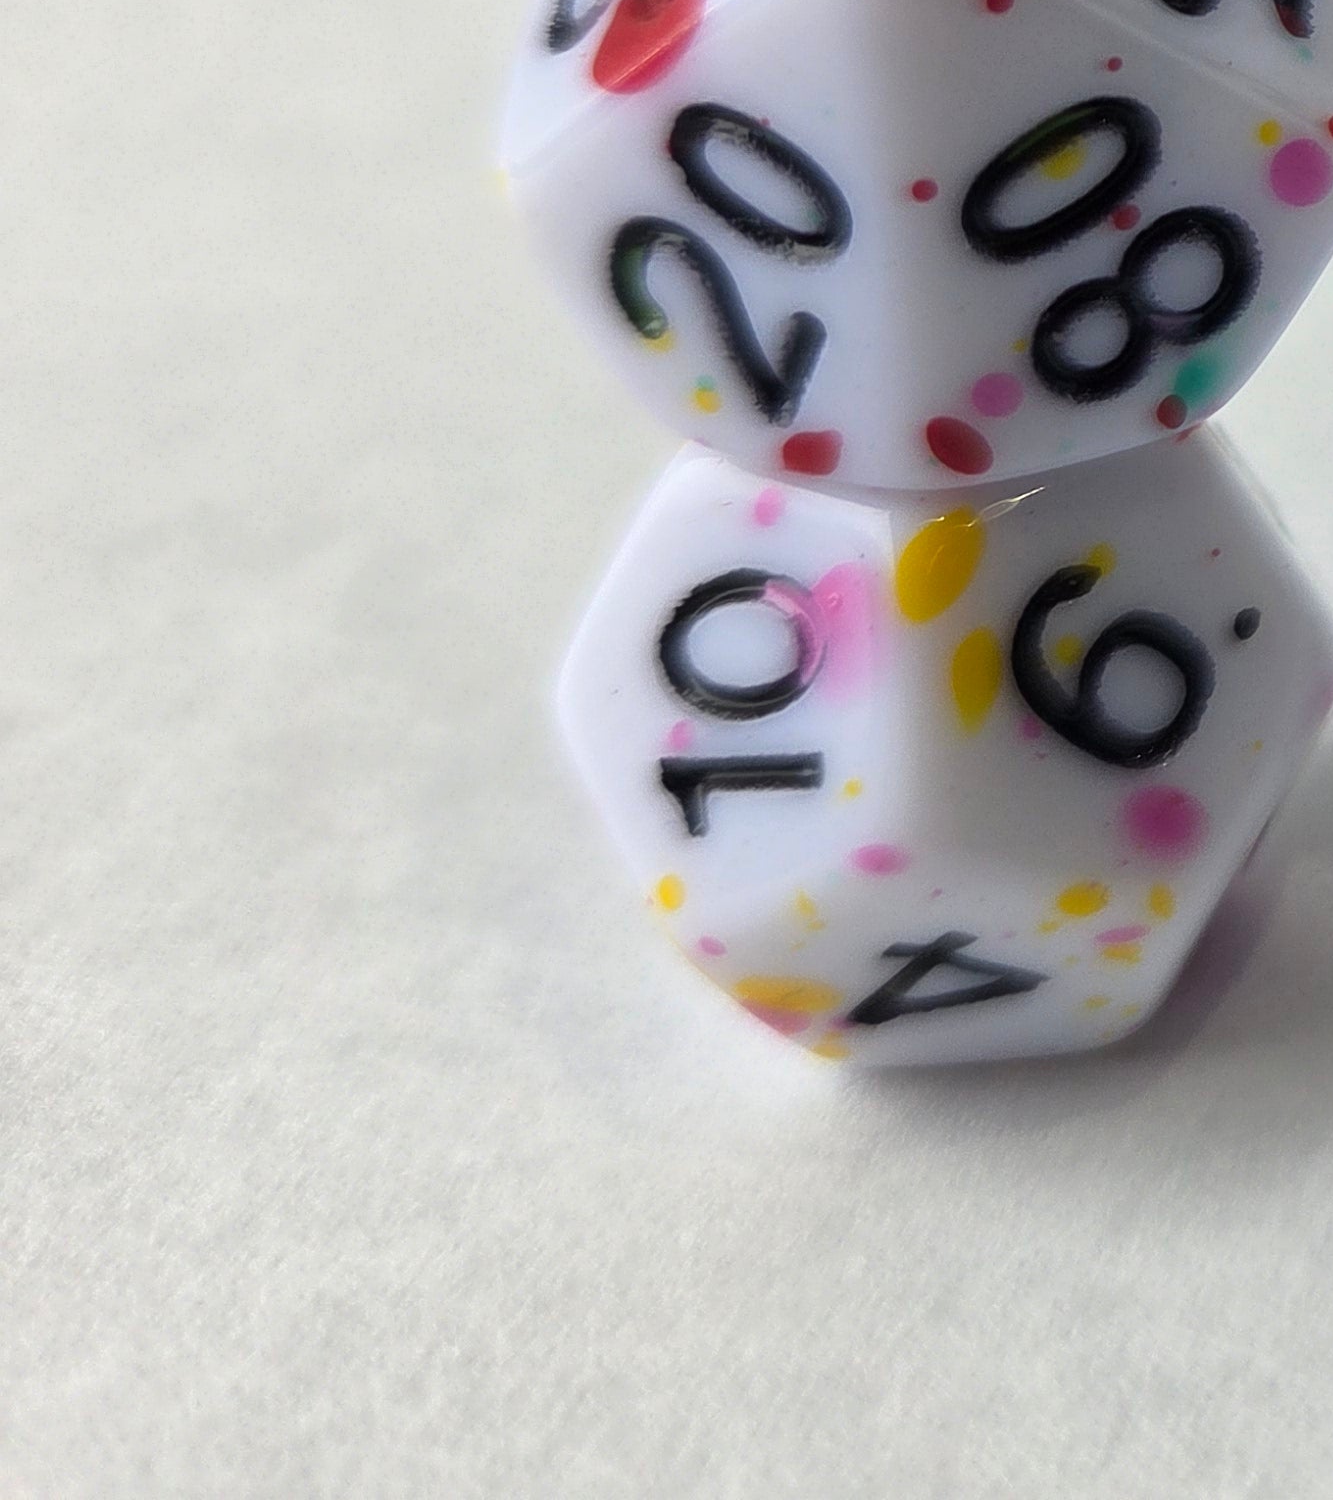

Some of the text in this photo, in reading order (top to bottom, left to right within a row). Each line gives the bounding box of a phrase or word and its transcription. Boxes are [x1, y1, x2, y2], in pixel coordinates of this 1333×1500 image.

[611, 104, 851, 424] 20
[661, 569, 825, 835] 10
[850, 933, 1048, 1024] 4
